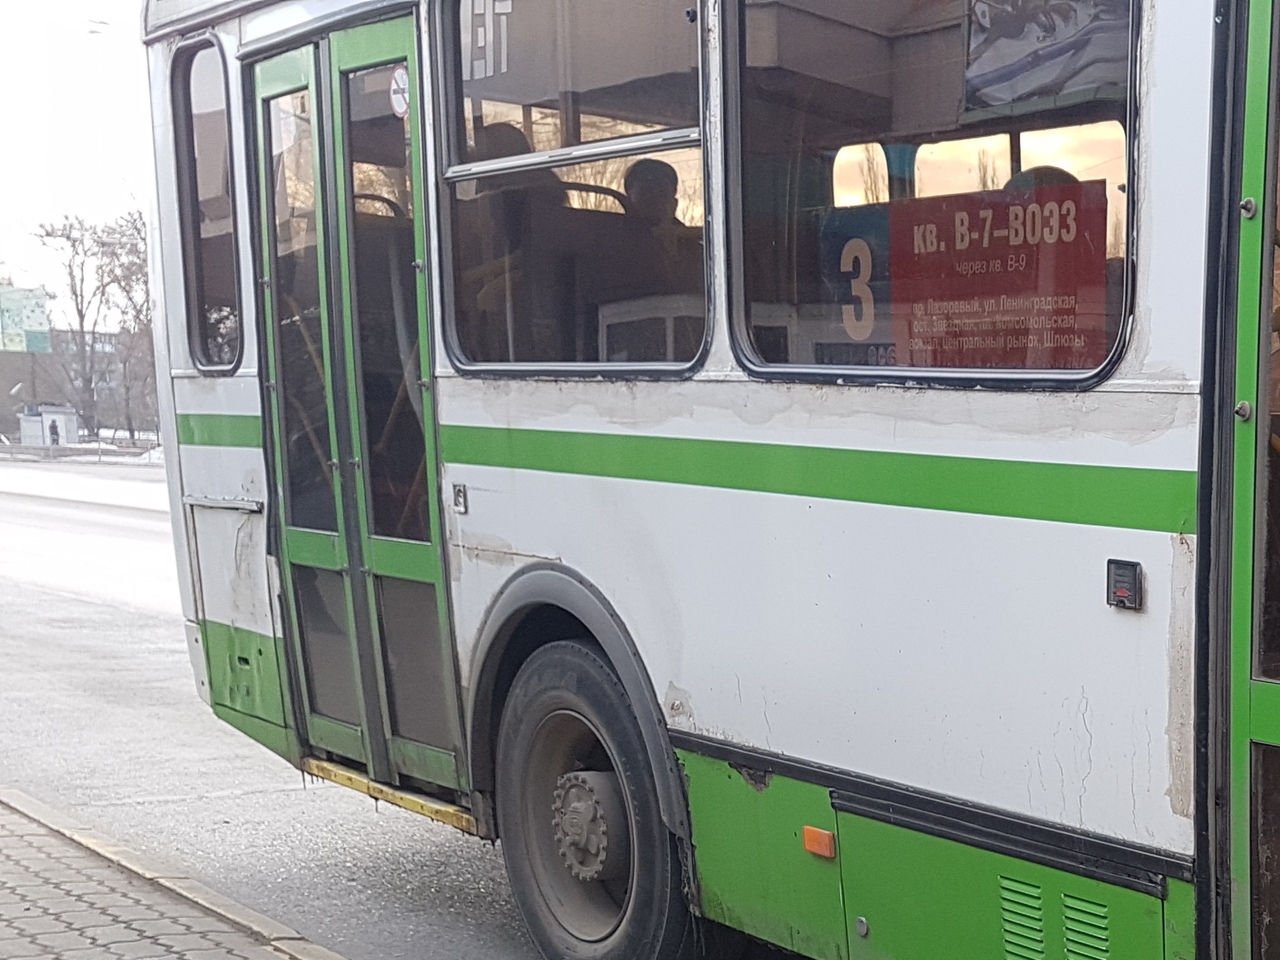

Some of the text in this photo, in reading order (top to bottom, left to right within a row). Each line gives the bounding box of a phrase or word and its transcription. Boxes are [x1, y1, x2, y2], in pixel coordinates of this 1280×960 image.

[956, 253, 1027, 278] через кв. В-9
[840, 237, 876, 341] 3
[983, 299, 999, 316] ул.
[1000, 294, 1080, 314] Ленинградская,
